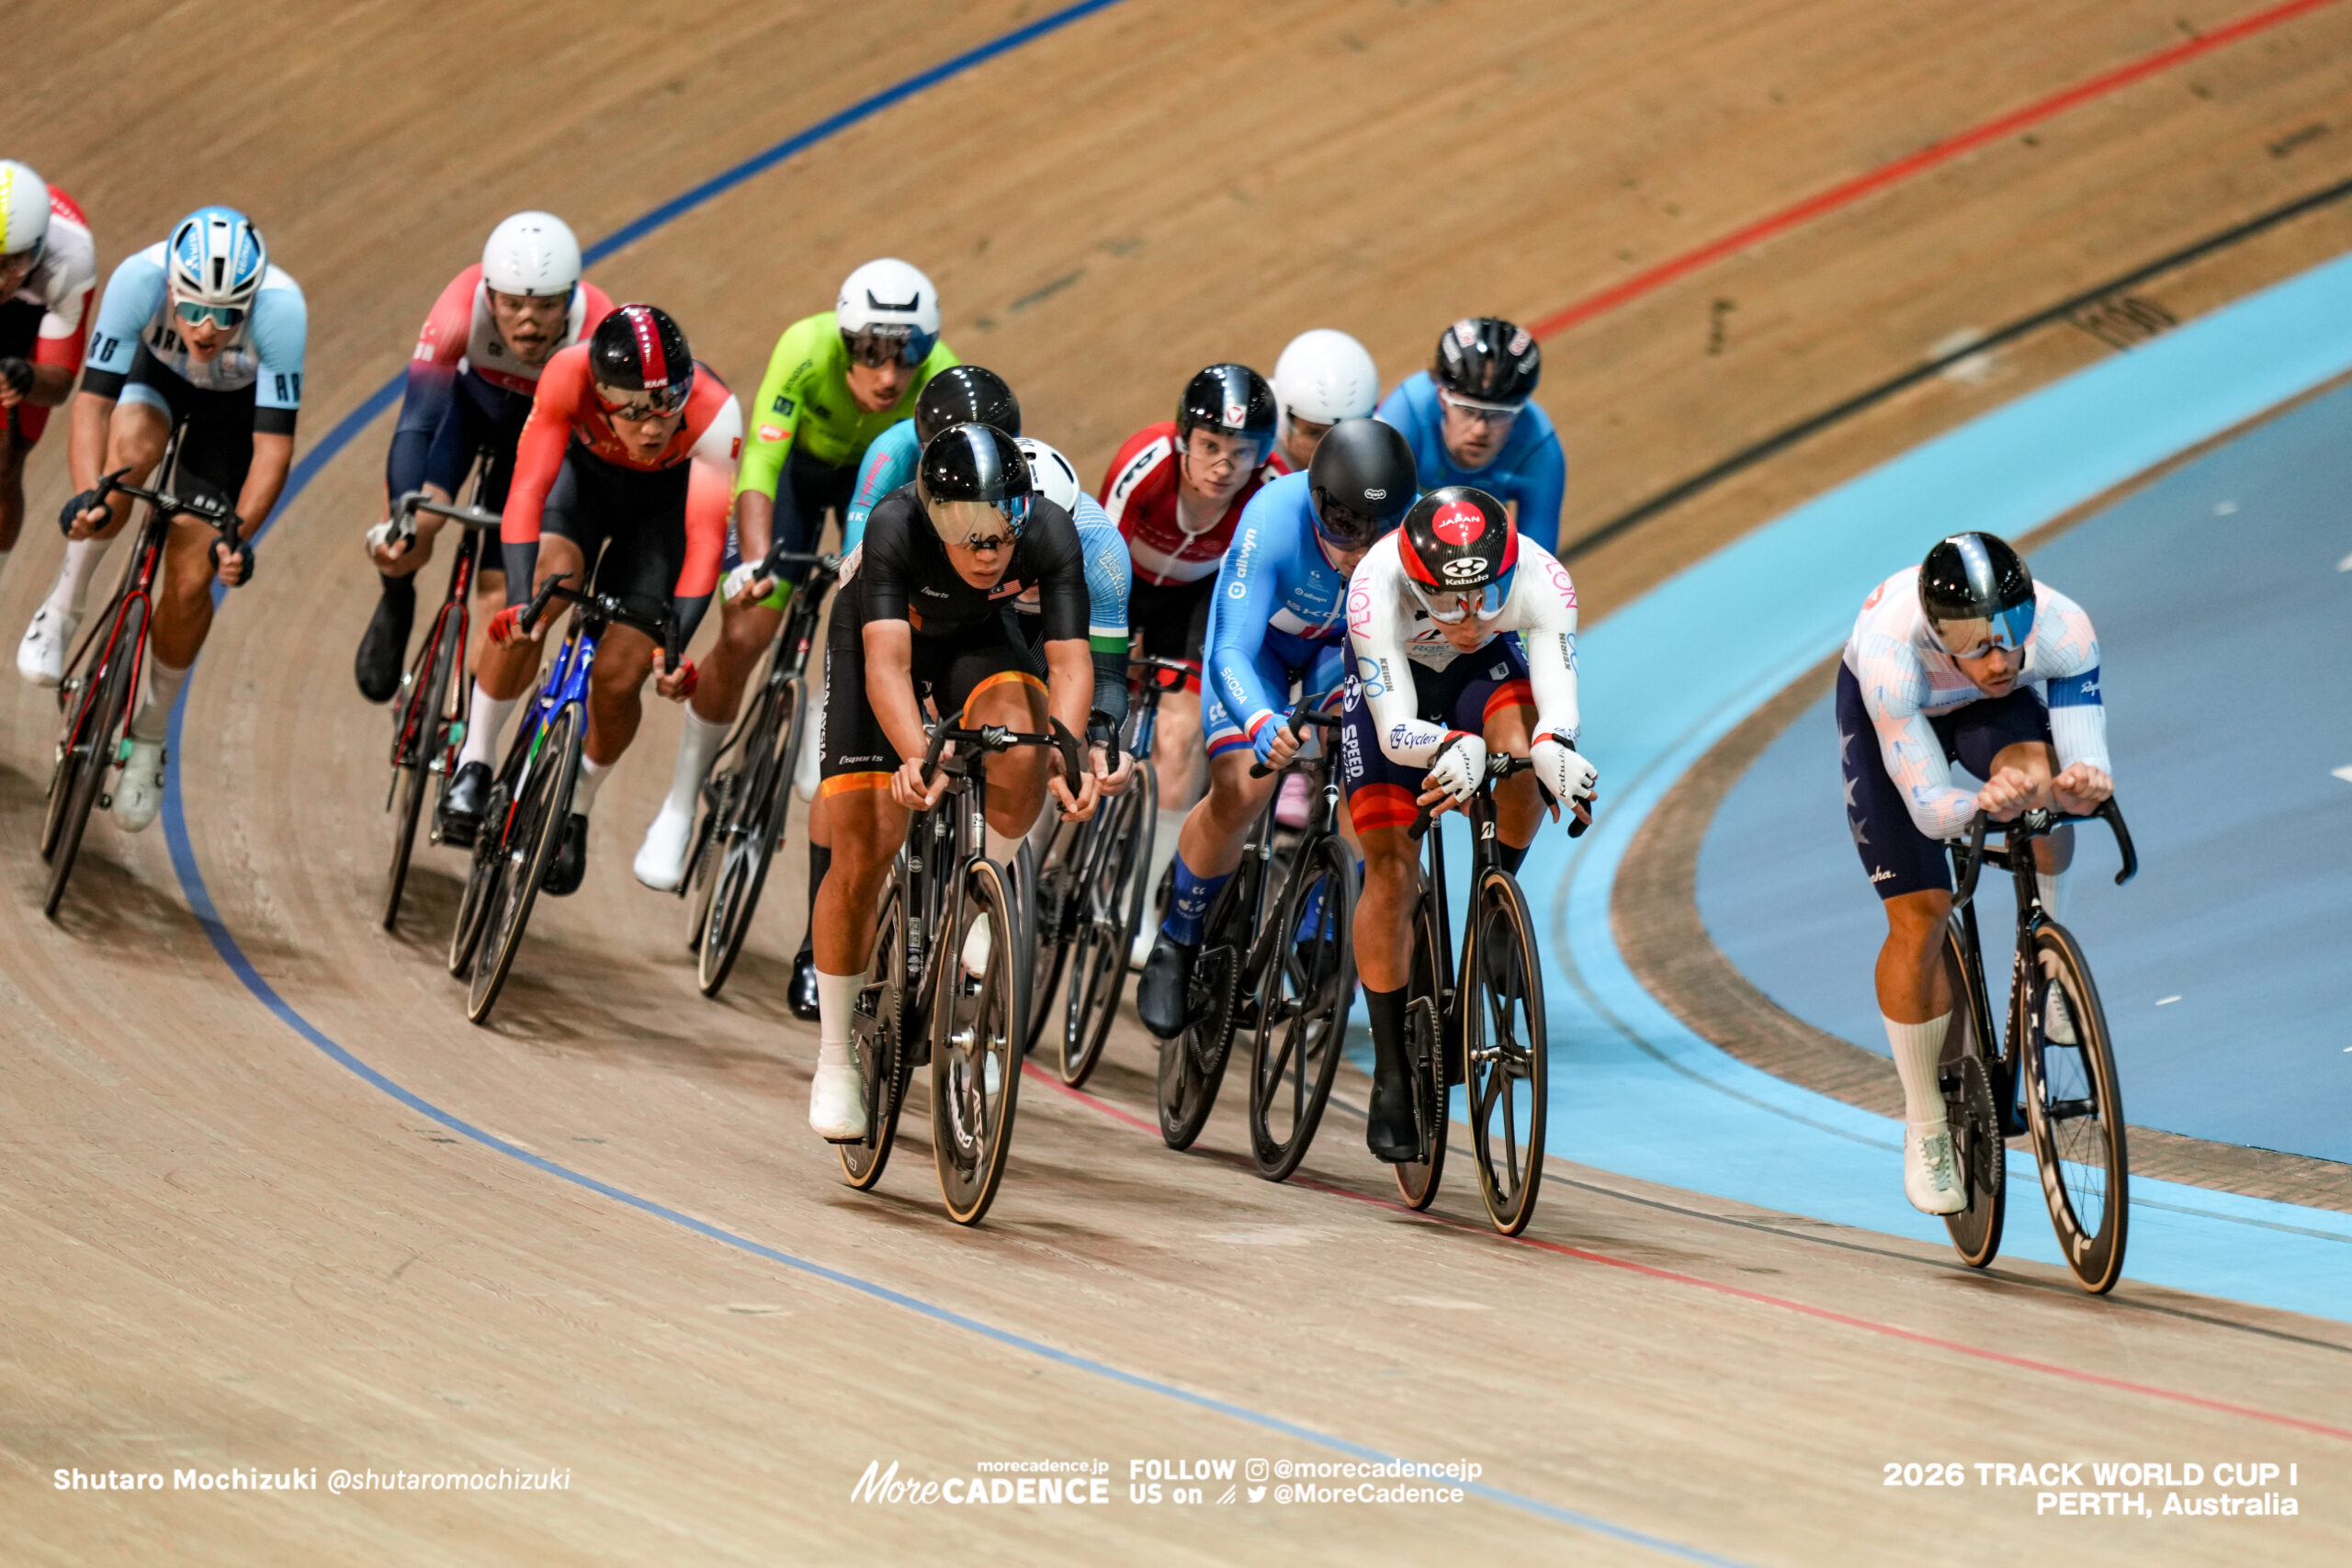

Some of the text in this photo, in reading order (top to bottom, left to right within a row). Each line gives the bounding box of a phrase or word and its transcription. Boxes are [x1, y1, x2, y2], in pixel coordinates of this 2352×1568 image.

[1437, 515, 1481, 529] JAPAN
[1236, 527, 1257, 579] allwyn
[1445, 573, 1489, 586] Kabuto
[1558, 632, 1571, 671] KEIRIN
[1379, 658, 1395, 693] KEIRIN
[1341, 724, 1364, 778] SPEED
[1404, 731, 1440, 750] Cyclers
